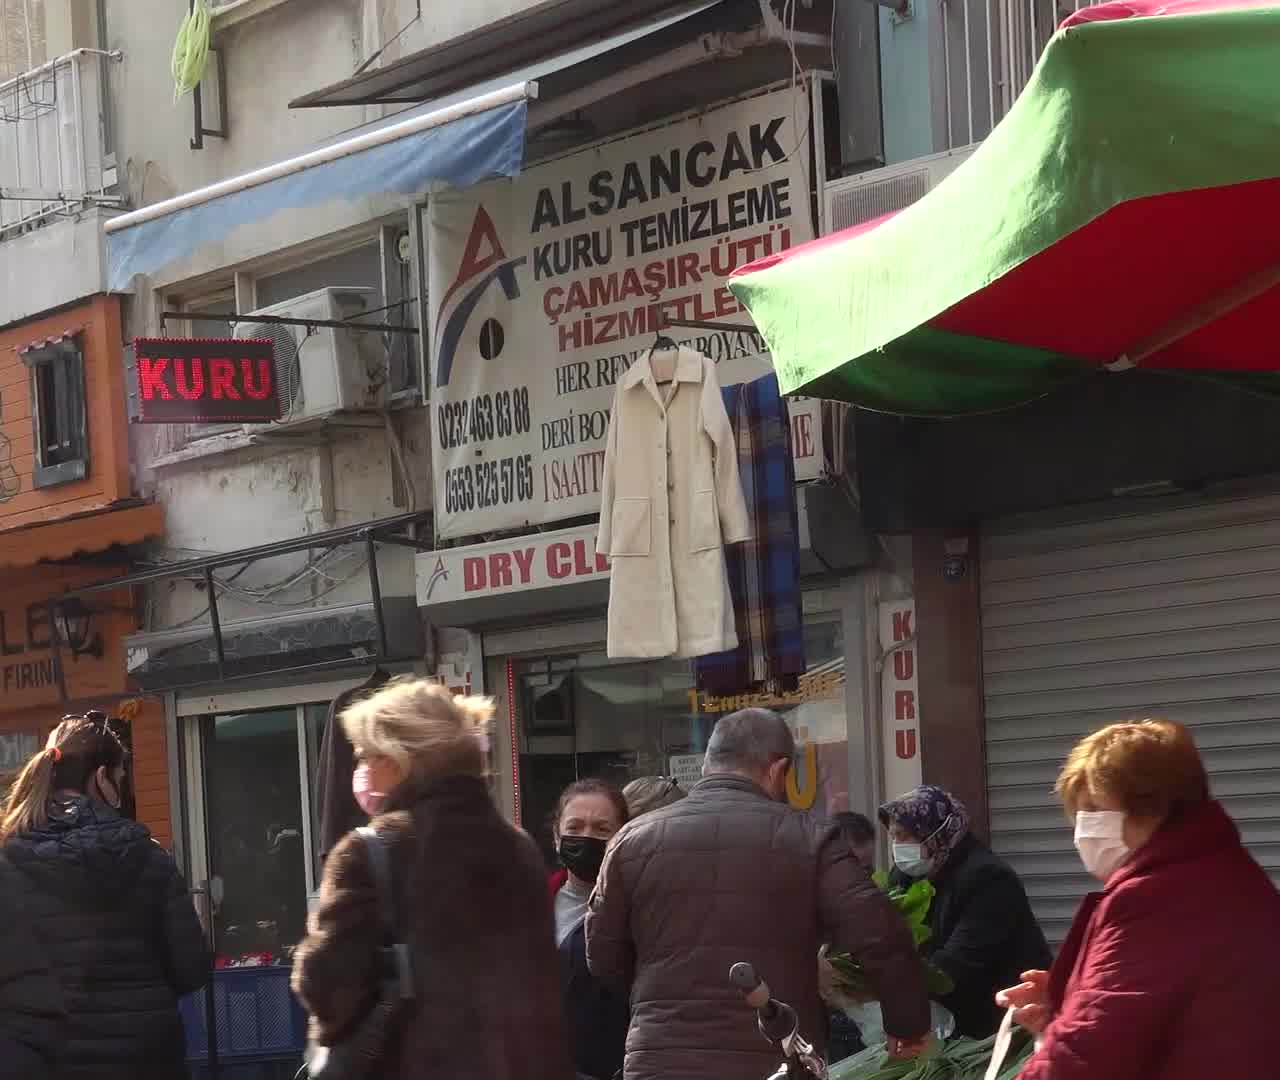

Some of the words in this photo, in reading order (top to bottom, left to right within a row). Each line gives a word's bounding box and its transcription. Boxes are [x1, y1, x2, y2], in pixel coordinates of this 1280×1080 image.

[531, 116, 789, 233] ALSANCAK
[534, 228, 613, 282] KURU
[620, 177, 792, 257] TEMİZLEME
[558, 287, 747, 352] HİZMETLE
[139, 357, 271, 400] KURU
[555, 356, 596, 395] HER
[438, 400, 468, 450] 0232
[470, 394, 494, 442] 463
[495, 390, 512, 438] 83
[513, 386, 530, 434] 88
[541, 408, 576, 450] DERİ
[578, 409, 612, 442] BO
[445, 465, 475, 514] 0553
[475, 460, 499, 508] 525
[500, 457, 514, 504] 57
[516, 453, 533, 501] 65
[551, 449, 606, 501] SAATT
[464, 547, 536, 592] DRY
[893, 610, 916, 759] KURU
